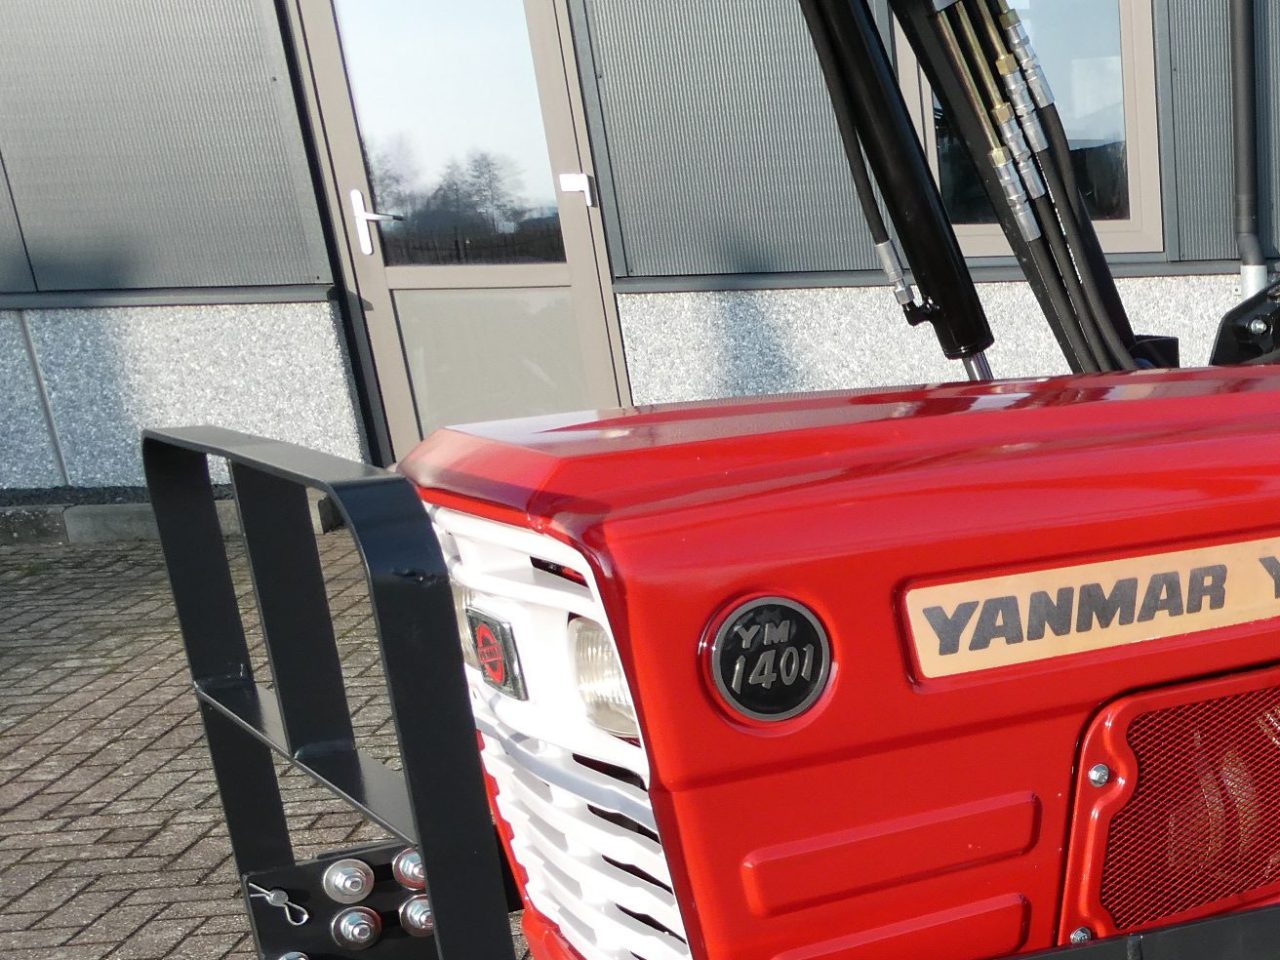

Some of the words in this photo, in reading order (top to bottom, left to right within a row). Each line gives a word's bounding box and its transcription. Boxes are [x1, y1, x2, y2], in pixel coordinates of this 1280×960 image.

[736, 620, 790, 649] YM
[922, 564, 1227, 656] YANMAR
[731, 643, 815, 694] 1401
